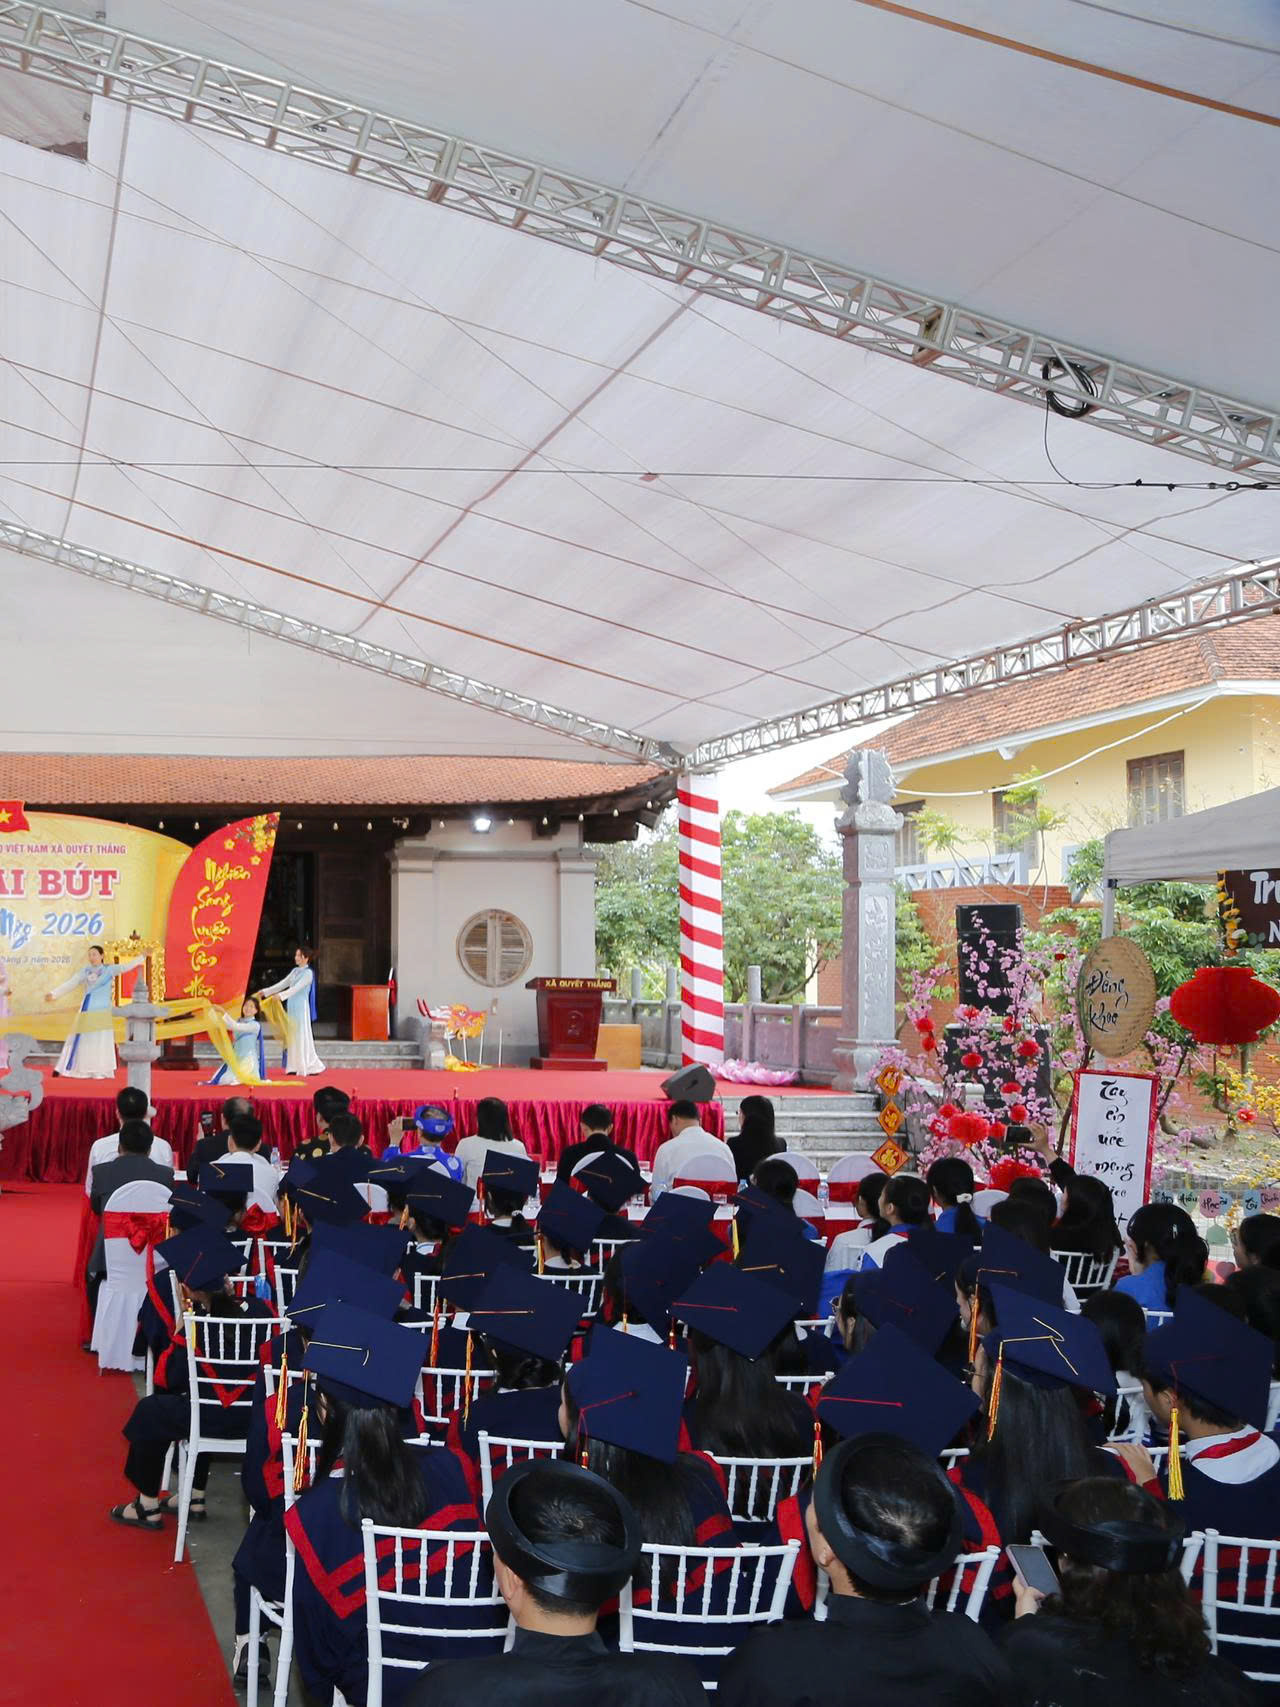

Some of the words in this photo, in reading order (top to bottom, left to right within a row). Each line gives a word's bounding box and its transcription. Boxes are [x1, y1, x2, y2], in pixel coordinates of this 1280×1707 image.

[27, 843, 49, 854] NAM
[38, 862, 119, 898] BÚT
[41, 912, 104, 936] 2026
